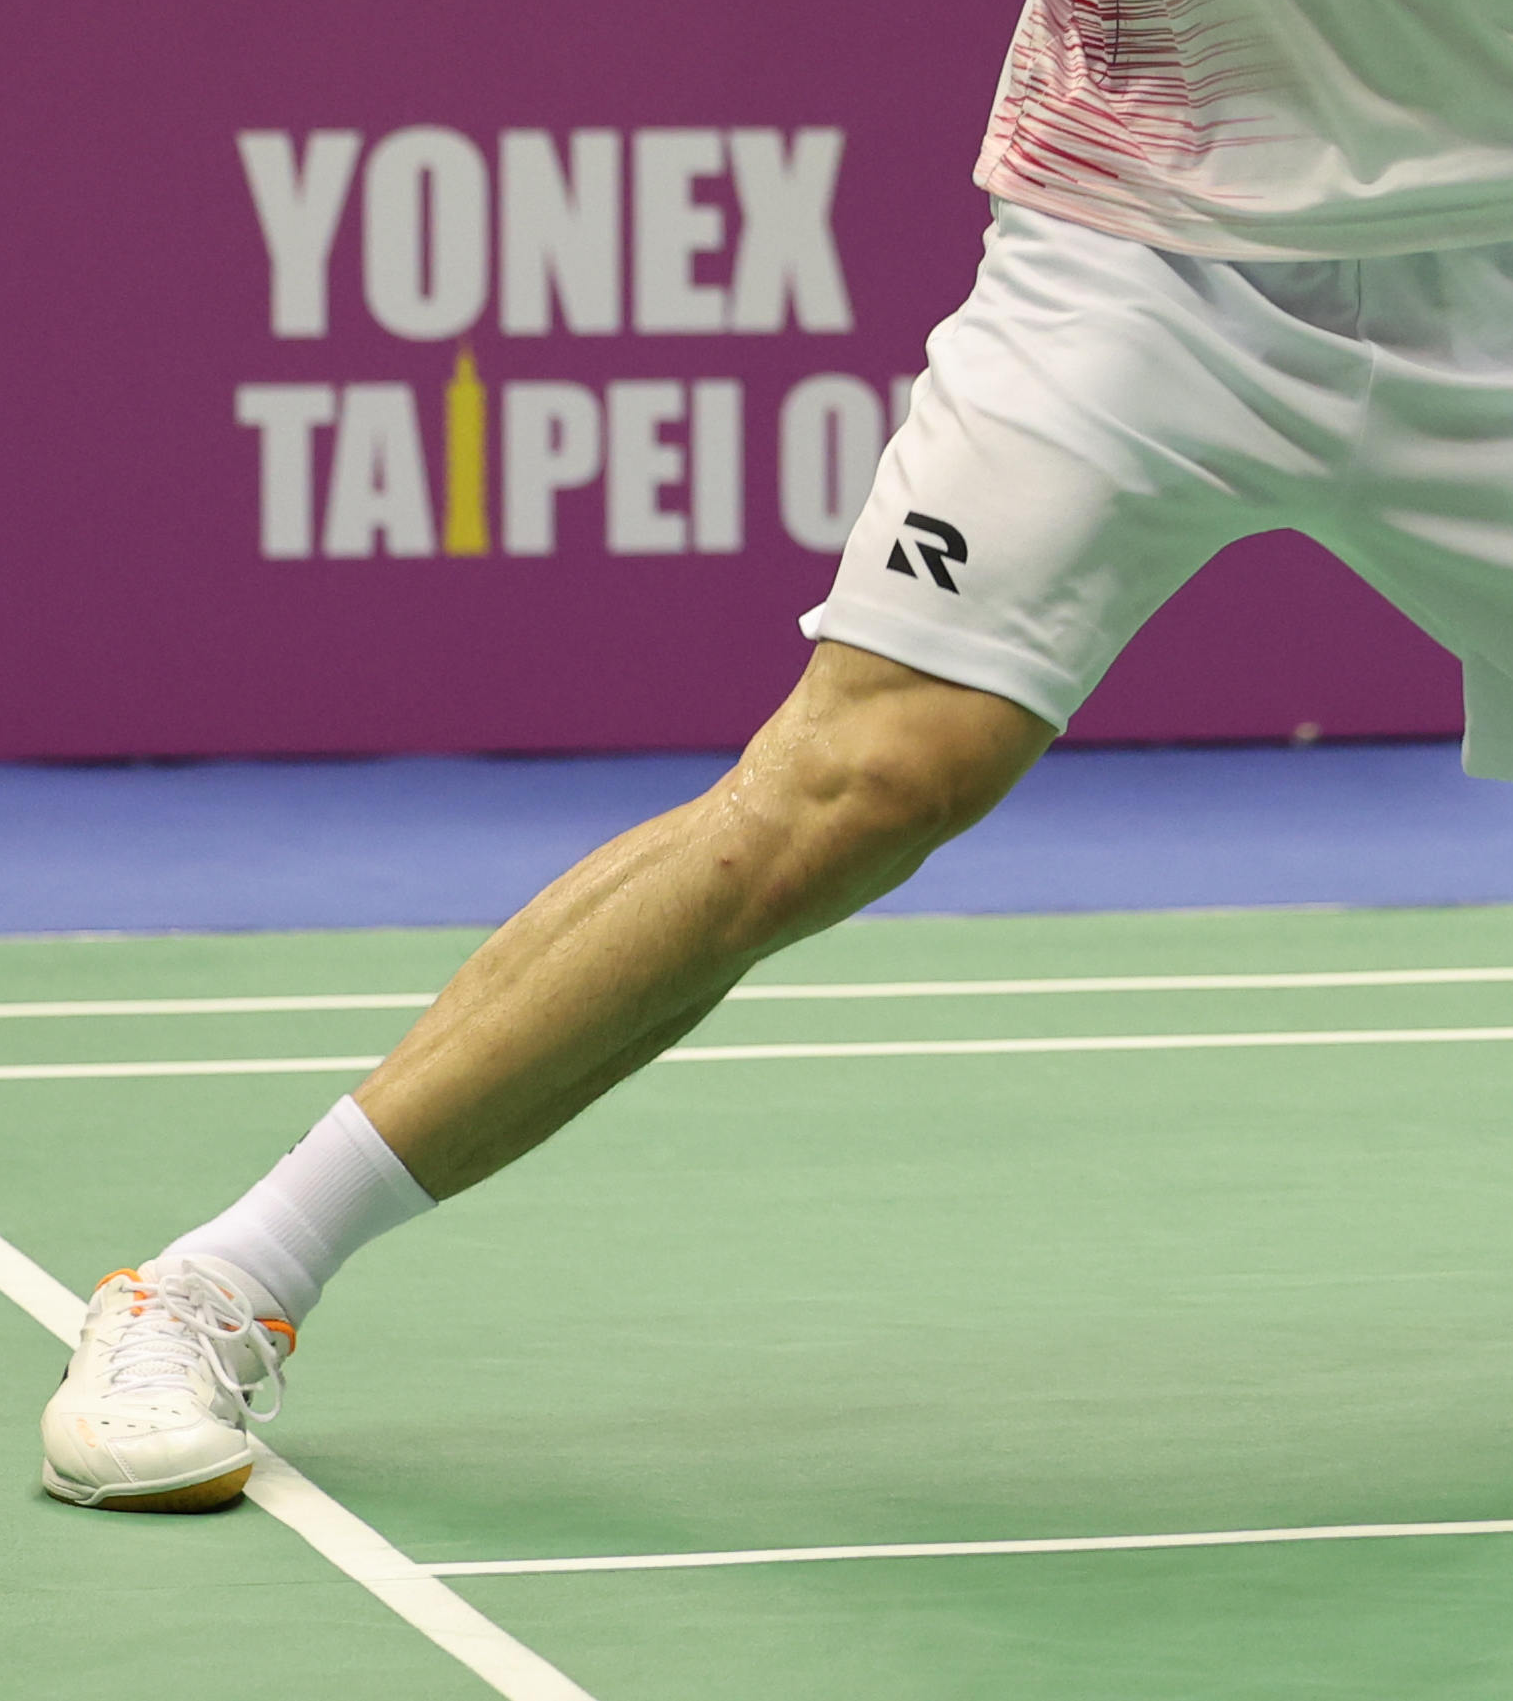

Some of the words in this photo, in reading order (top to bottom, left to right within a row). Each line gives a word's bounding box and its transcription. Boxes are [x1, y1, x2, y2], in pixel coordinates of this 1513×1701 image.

[238, 126, 852, 340] YONEX
[236, 345, 744, 558] TAIPEI
[779, 373, 911, 554] O
